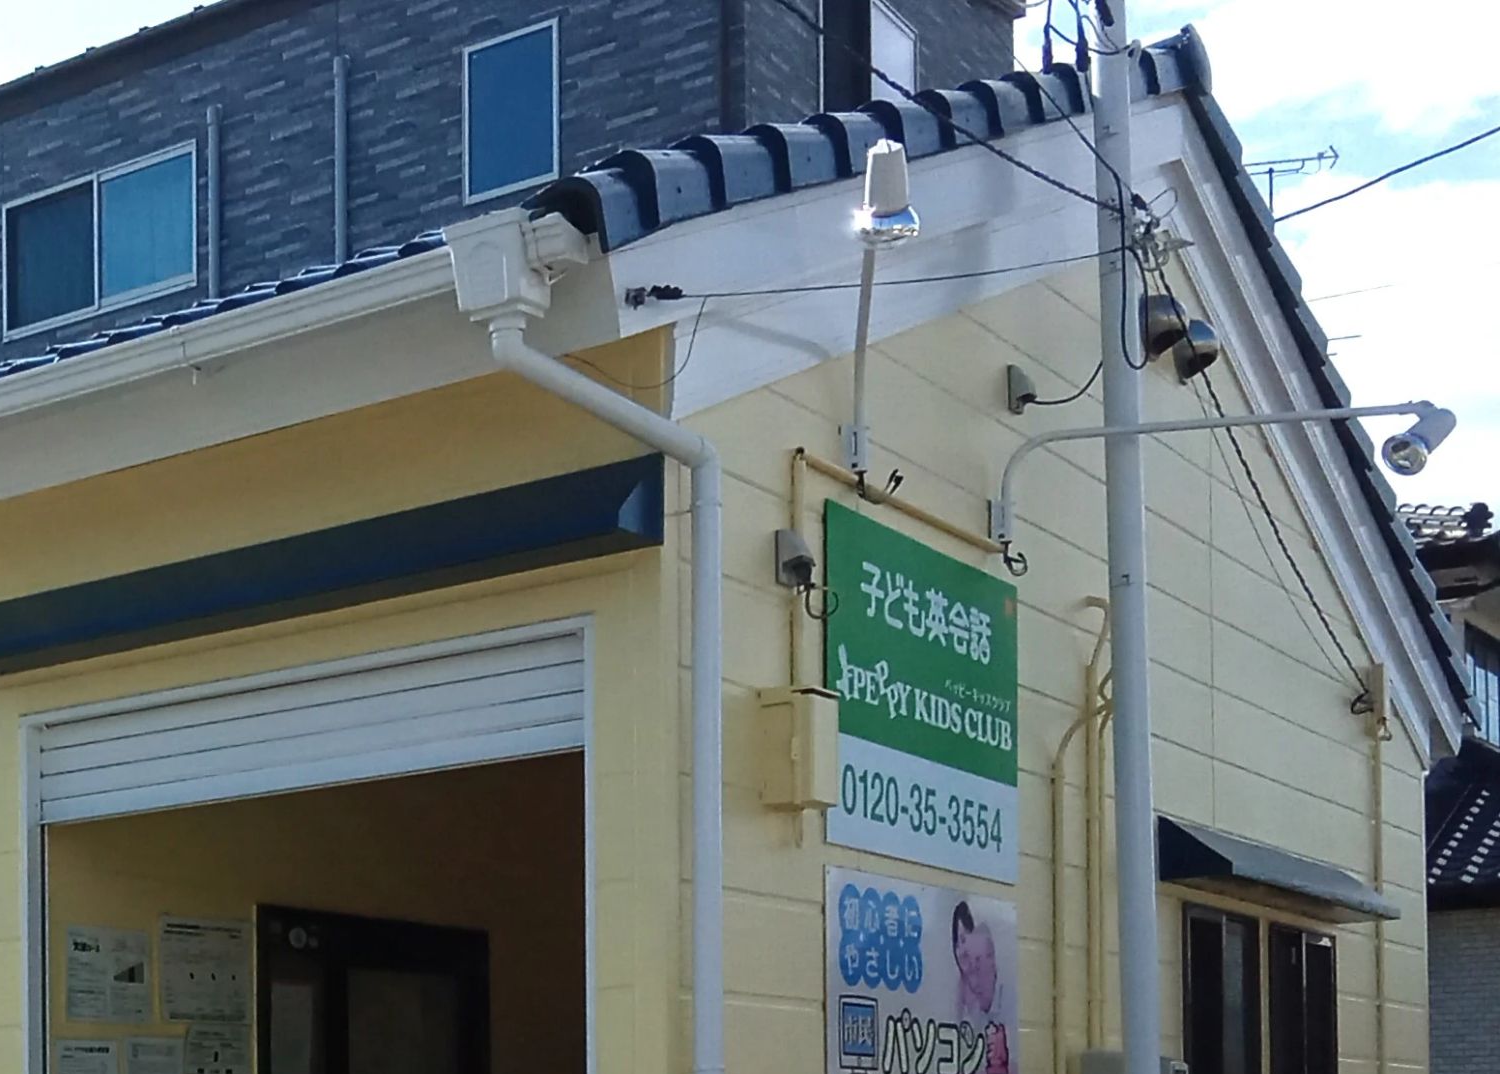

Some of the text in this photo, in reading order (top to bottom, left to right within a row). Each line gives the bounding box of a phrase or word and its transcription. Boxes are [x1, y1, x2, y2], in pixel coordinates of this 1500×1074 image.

[861, 561, 992, 664] 子ども英会話
[914, 687, 962, 735] KIDS
[965, 707, 1012, 751] CLUB
[842, 764, 1003, 853] 0120-35-3554
[844, 897, 920, 939] 初心者に
[844, 943, 920, 981] やさしい
